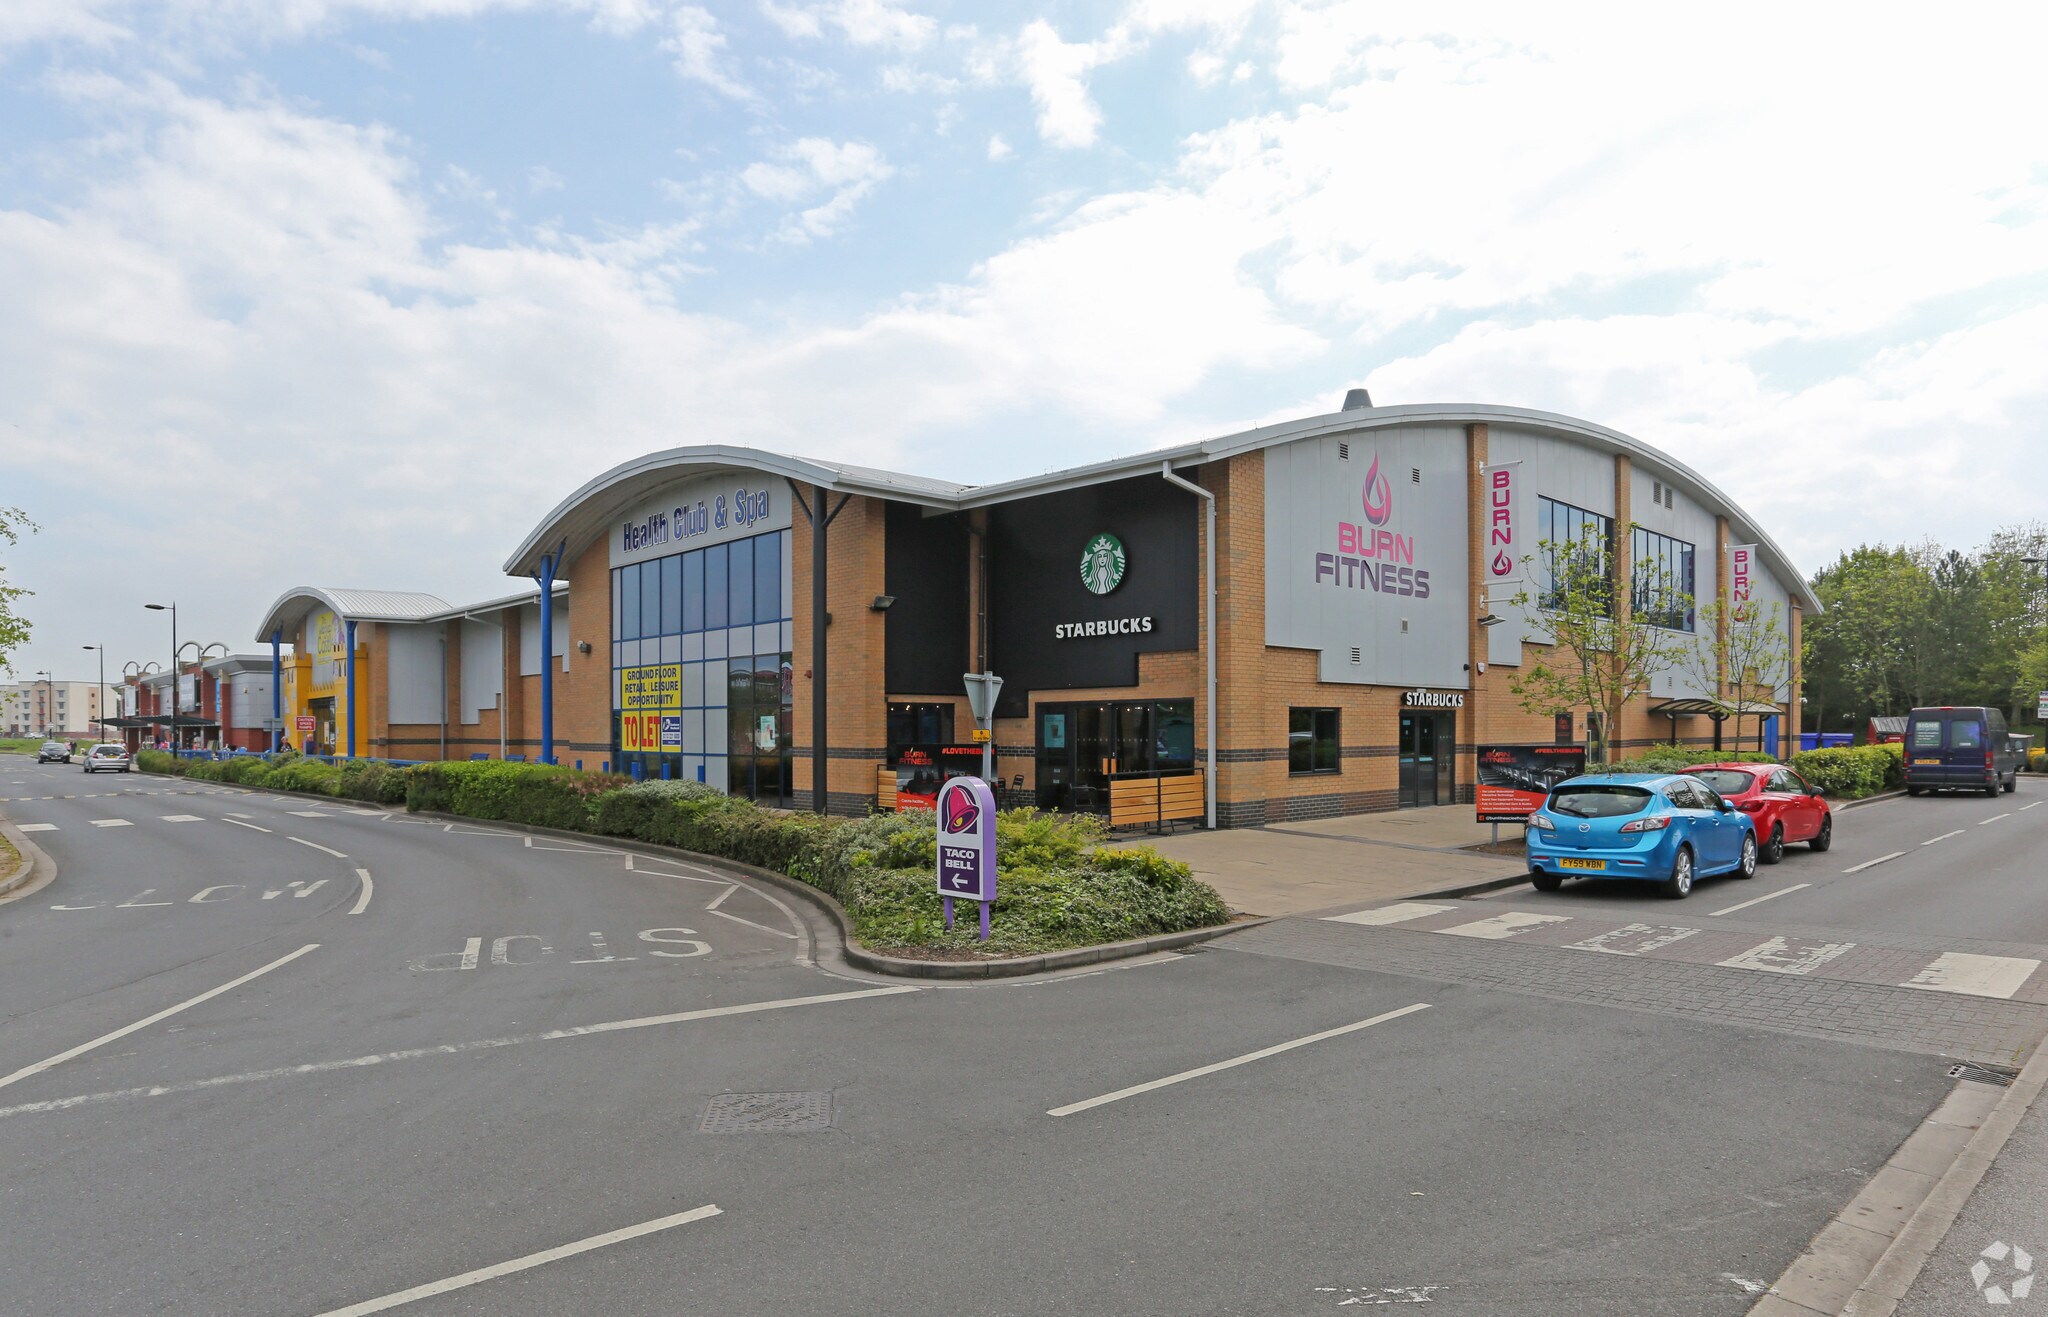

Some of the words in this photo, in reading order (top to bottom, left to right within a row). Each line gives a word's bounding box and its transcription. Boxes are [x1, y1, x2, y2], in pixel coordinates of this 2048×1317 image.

[1491, 470, 1511, 546] BURN
[623, 512, 669, 552] Health
[673, 501, 708, 540] Club
[714, 494, 728, 529] &
[734, 488, 769, 528] Spa
[1338, 521, 1414, 566] BURN
[1315, 552, 1430, 599] FITNESS
[1733, 550, 1749, 602] BURN
[1055, 616, 1153, 639] STARBUCKS
[628, 670, 654, 680] GROUND
[655, 668, 676, 678] FLOOR
[625, 684, 646, 693] RETAIL
[651, 681, 678, 691] LEISURE
[628, 695, 674, 705] OPPORTUNITY
[1406, 691, 1464, 708] STARBUCKS
[624, 716, 638, 747] TO
[641, 716, 660, 747] LET
[945, 848, 975, 859] TACO
[945, 859, 974, 871] BELL
[1562, 859, 1584, 868] FY59
[1586, 860, 1602, 869] WBN
